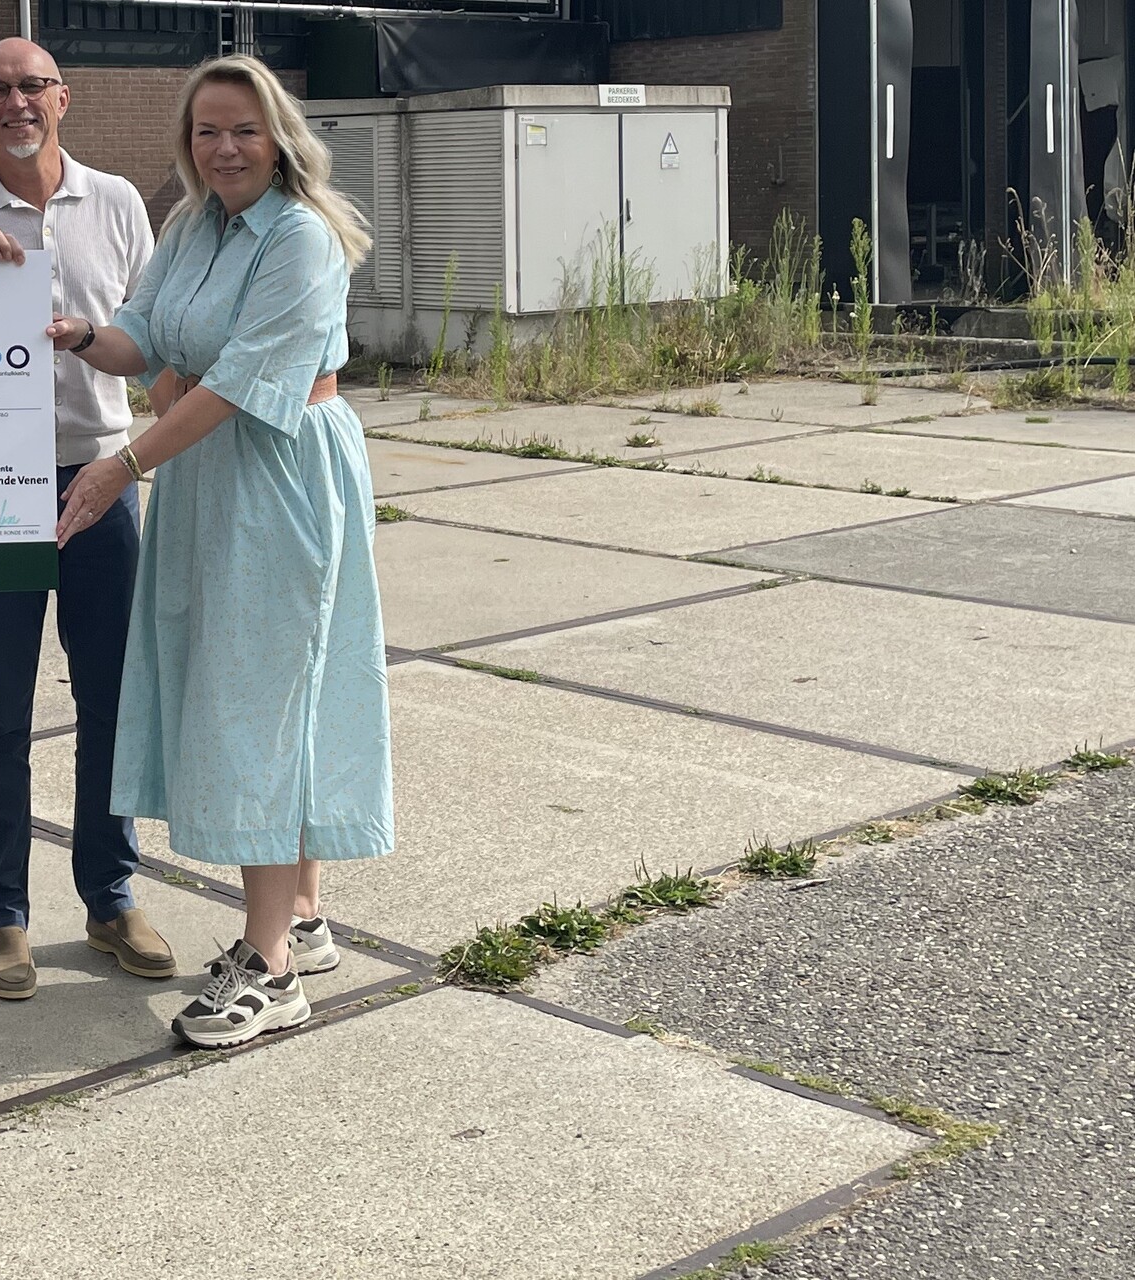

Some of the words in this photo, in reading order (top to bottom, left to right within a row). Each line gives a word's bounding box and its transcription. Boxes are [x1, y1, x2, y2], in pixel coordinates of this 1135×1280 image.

[608, 87, 638, 95] PARKEREN
[607, 96, 641, 104] BEZOEKERS
[18, 476, 49, 485] Venen
